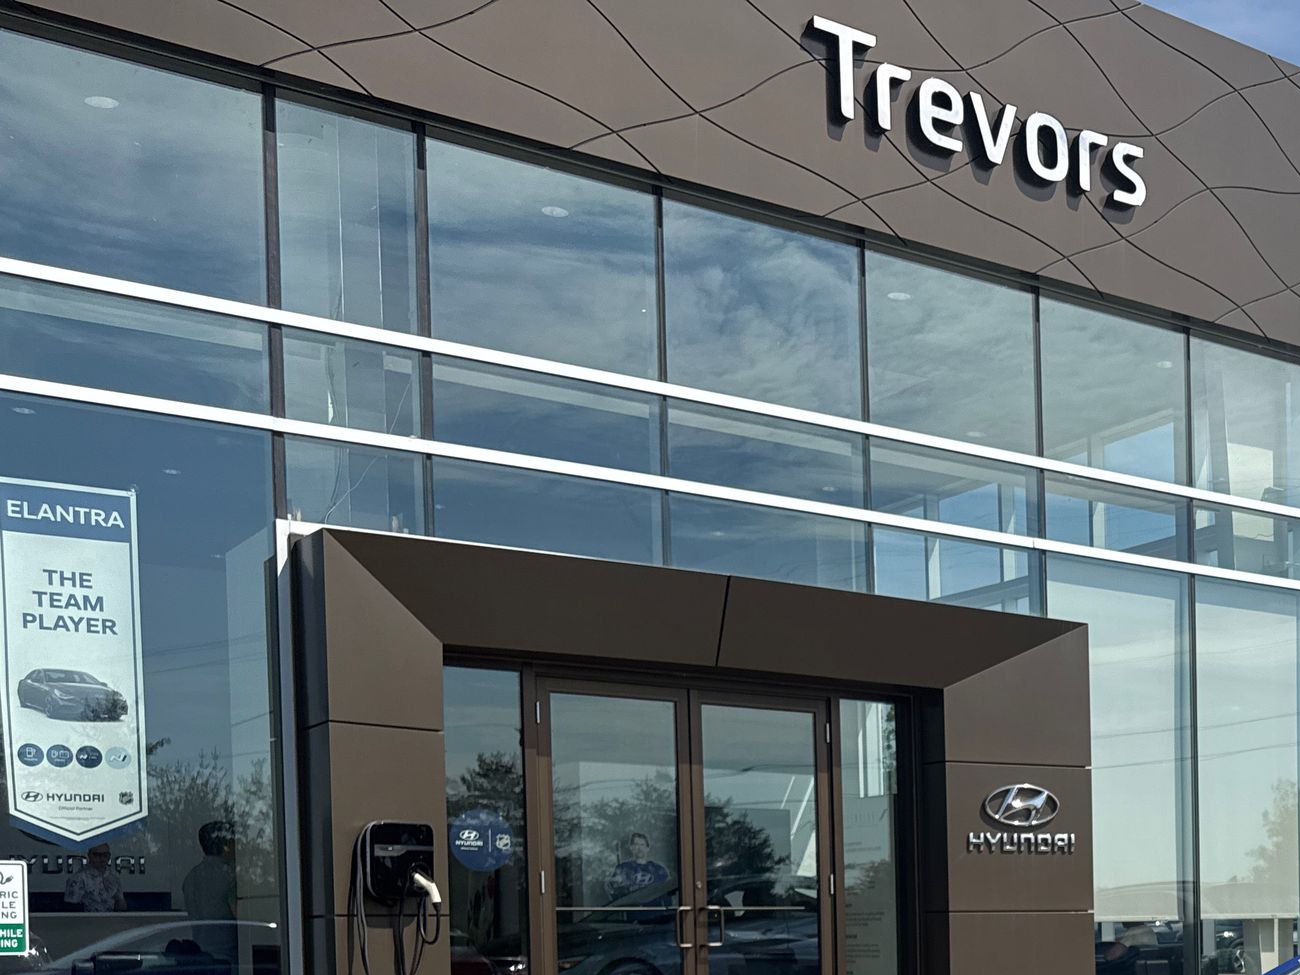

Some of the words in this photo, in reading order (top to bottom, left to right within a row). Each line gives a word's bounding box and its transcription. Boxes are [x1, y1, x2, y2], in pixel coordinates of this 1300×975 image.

[812, 14, 1148, 208] Trevors
[6, 499, 125, 529] ELANTRA
[42, 568, 94, 589] THE
[32, 590, 105, 612] TEAM
[22, 612, 118, 635] PLAYER
[46, 793, 105, 803] HYUNDAI
[968, 831, 1076, 854] HYUNDAI
